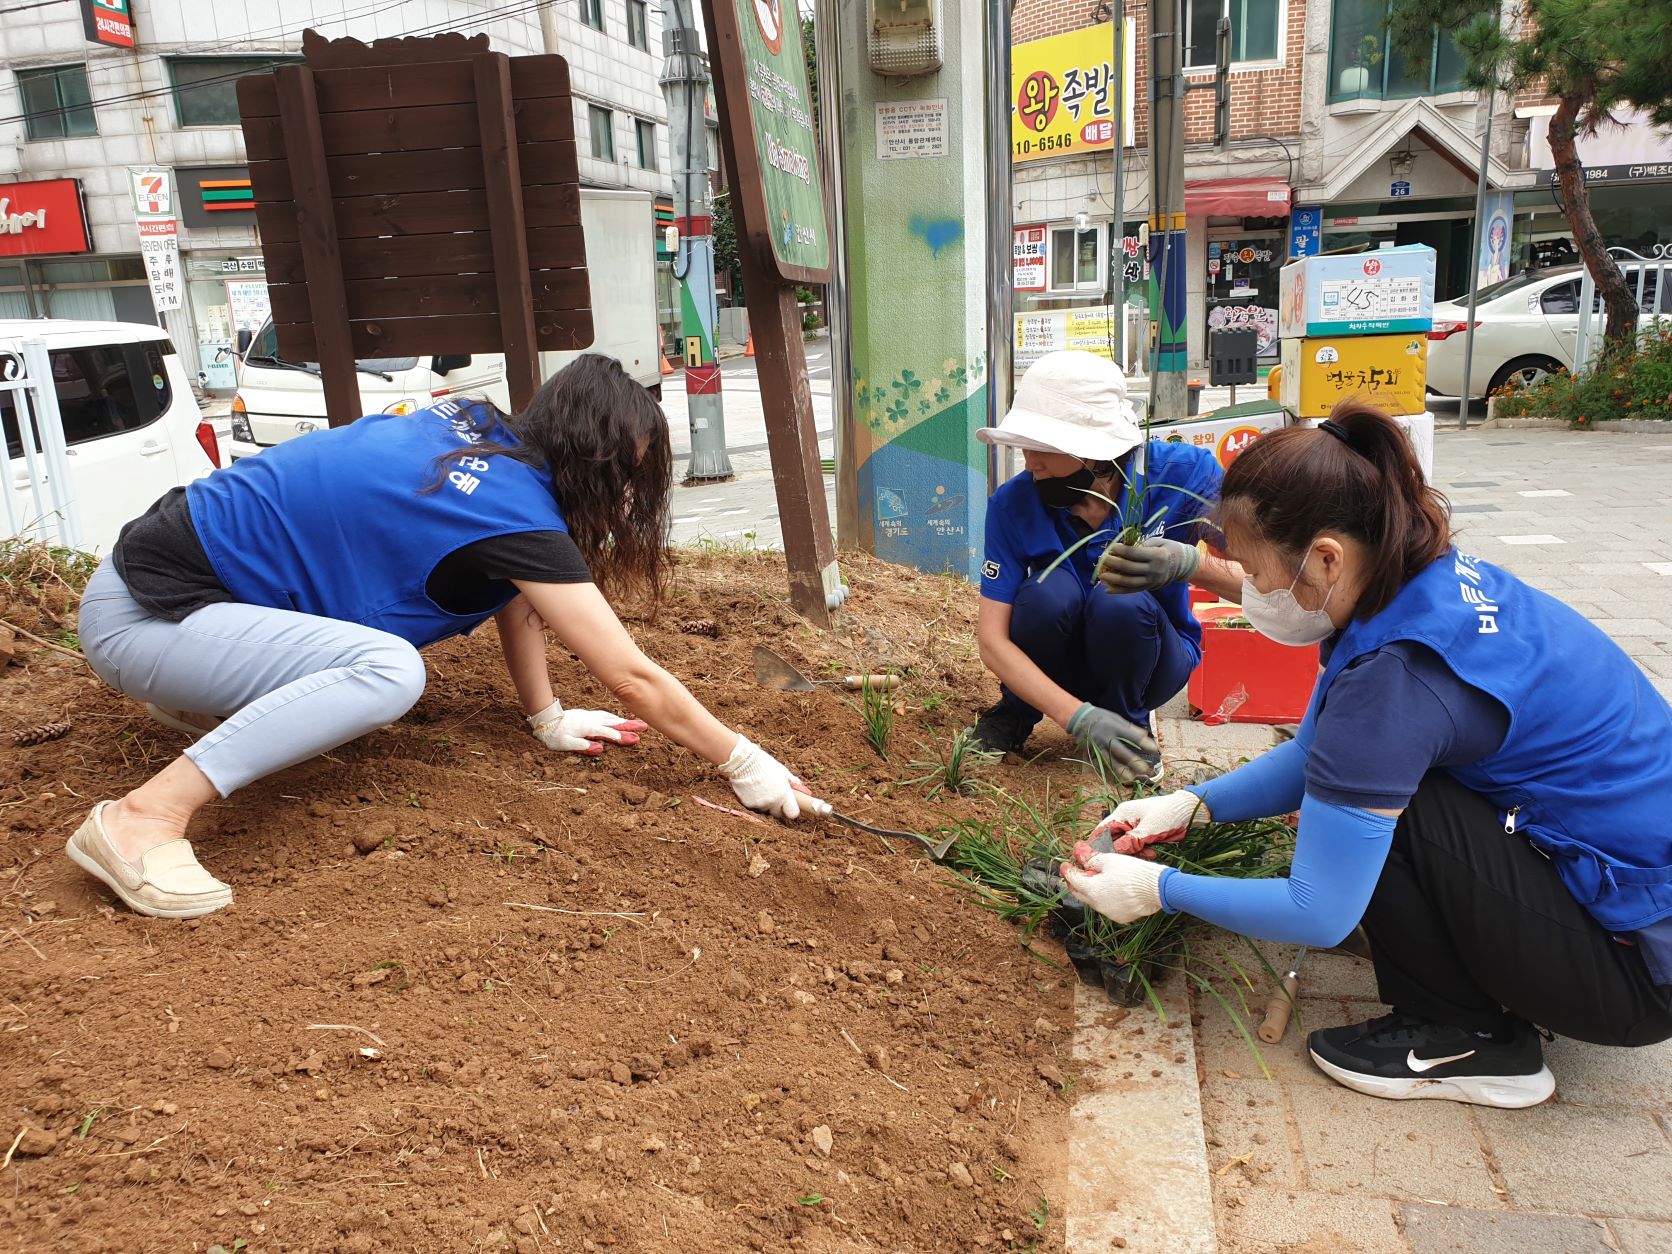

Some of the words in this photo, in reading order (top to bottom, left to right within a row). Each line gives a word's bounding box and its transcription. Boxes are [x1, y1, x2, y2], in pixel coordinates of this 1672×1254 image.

[1012, 64, 1114, 132] 왕족발
[1085, 122, 1113, 141] 배달
[1585, 169, 1608, 180] 1984
[138, 193, 169, 202] ELEVEN
[1395, 188, 1406, 196] 26
[1193, 433, 1215, 446] 참외
[885, 527, 910, 538] 경기도
[936, 527, 964, 536] 안산시
